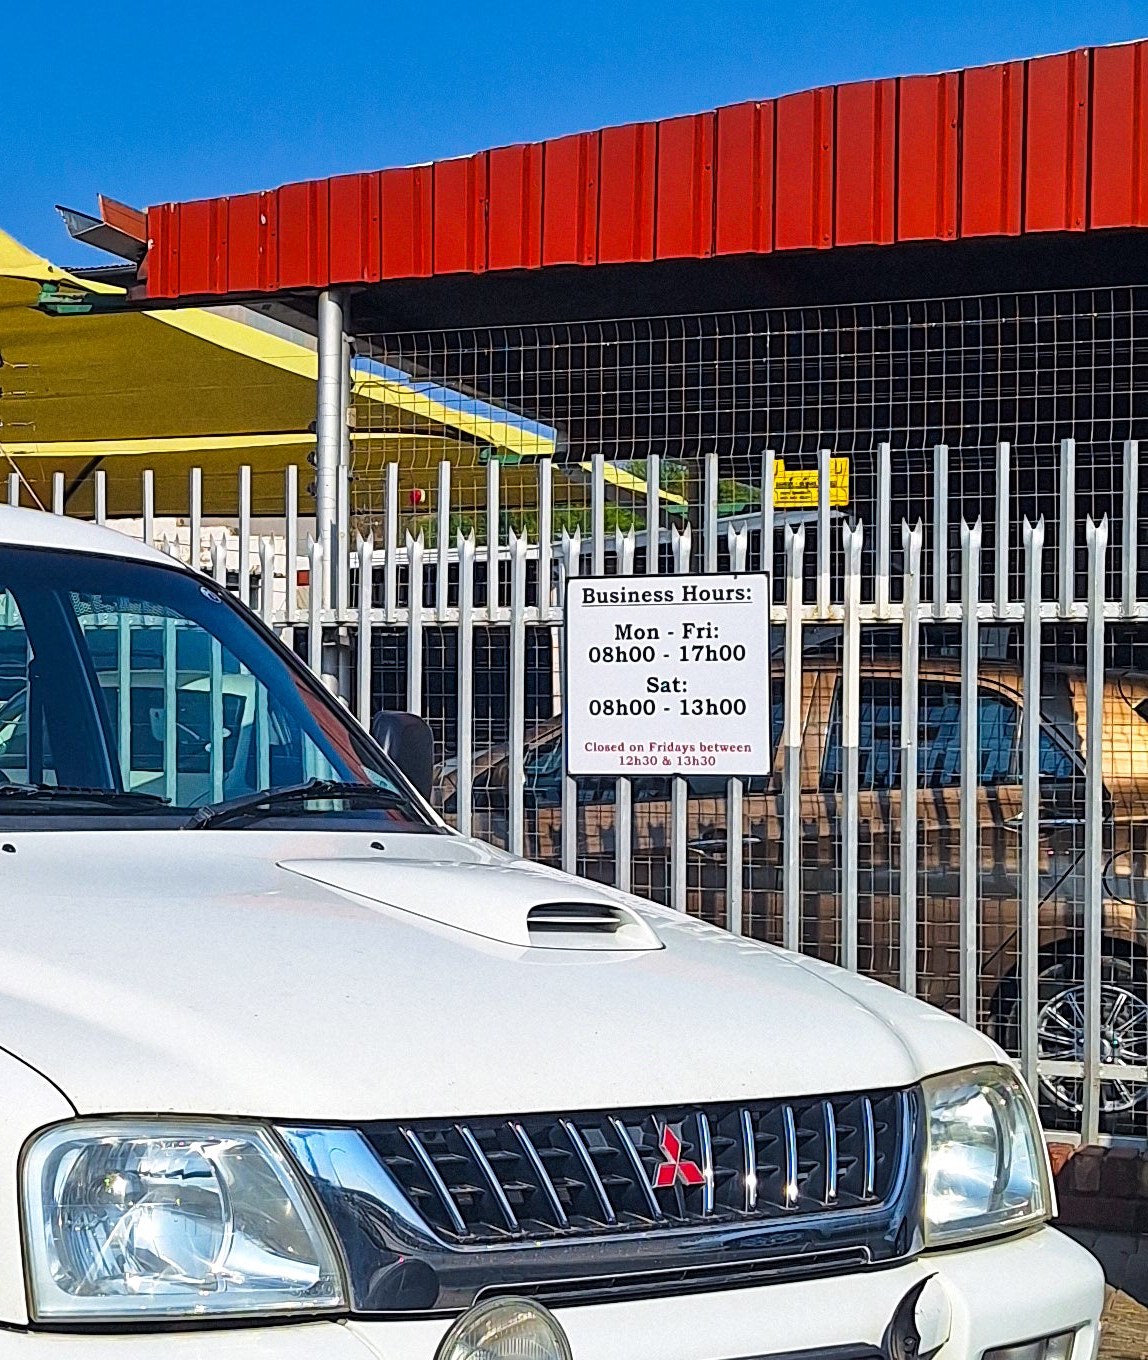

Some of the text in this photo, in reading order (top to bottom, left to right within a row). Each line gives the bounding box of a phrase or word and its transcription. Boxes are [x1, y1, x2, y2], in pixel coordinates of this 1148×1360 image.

[581, 585, 752, 604] Business Hours:
[614, 623, 660, 640] Mon
[681, 622, 719, 639] Fri:
[588, 646, 655, 663] 08h00
[679, 644, 746, 661] 17h00
[646, 677, 688, 693] Sat:
[588, 699, 656, 716] 08h00
[680, 698, 747, 715] 13h00
[584, 742, 752, 754] Closed on Fridays between
[619, 756, 716, 766] 12h30 & 13h30
